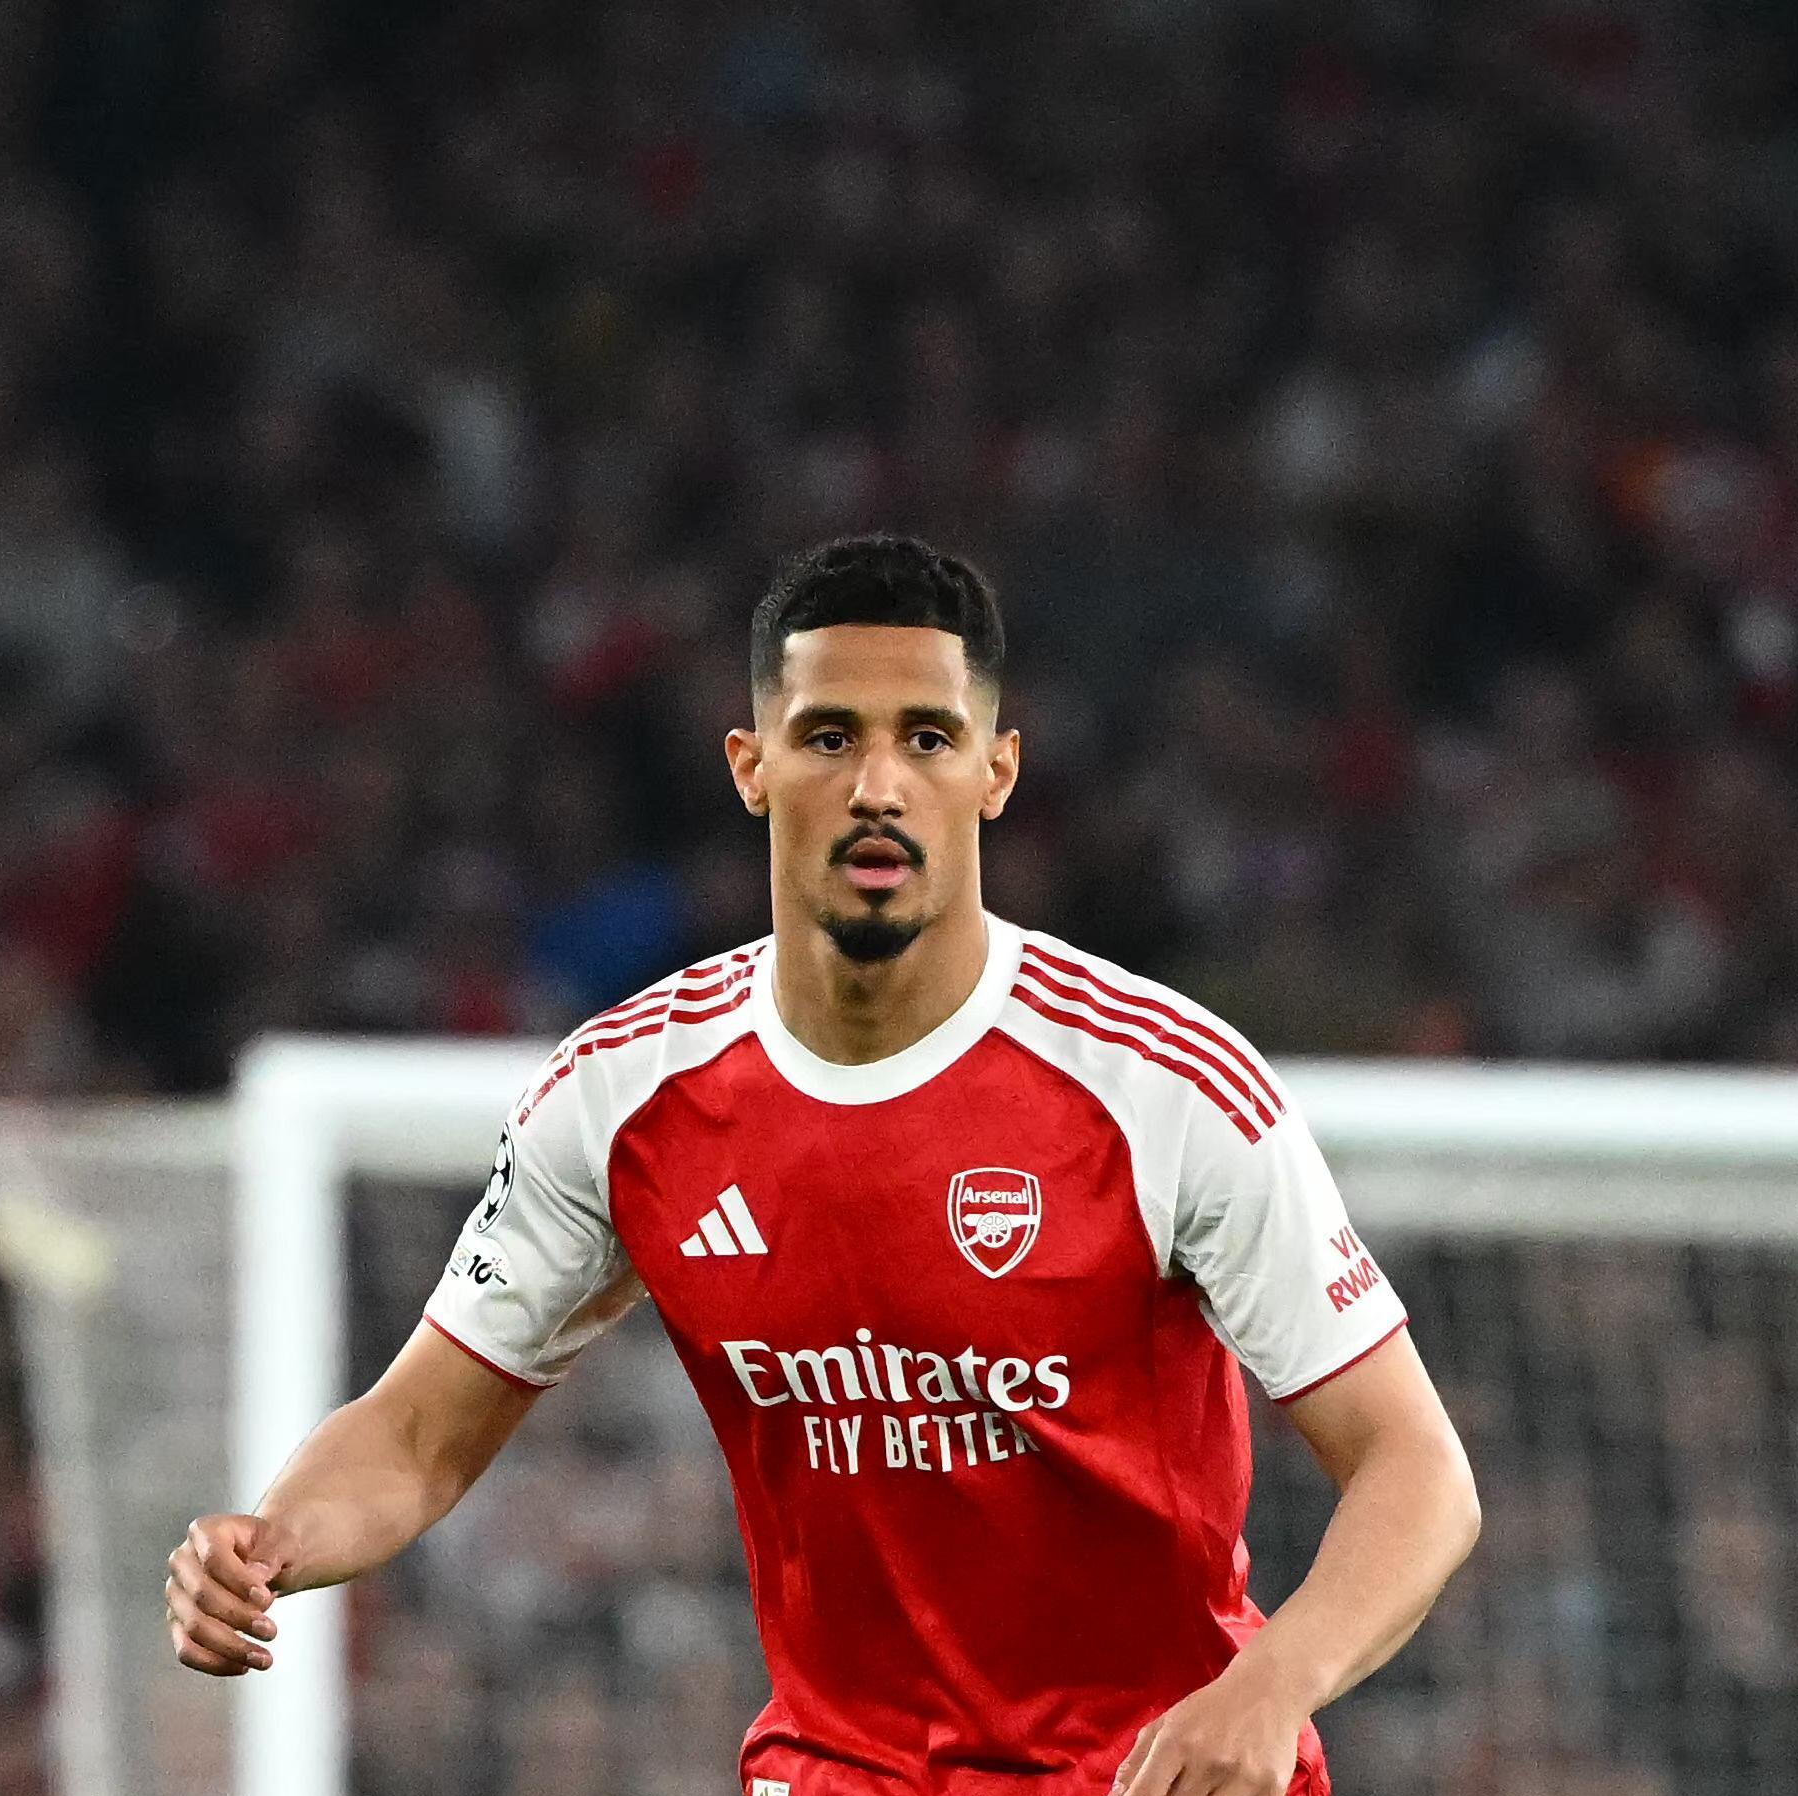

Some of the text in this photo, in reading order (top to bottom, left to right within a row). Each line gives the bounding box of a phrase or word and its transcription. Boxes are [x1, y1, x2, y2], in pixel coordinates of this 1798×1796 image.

[961, 1186, 1028, 1204] Arsenal
[719, 1327, 1070, 1412] Emirates
[803, 1414, 863, 1475] FLY
